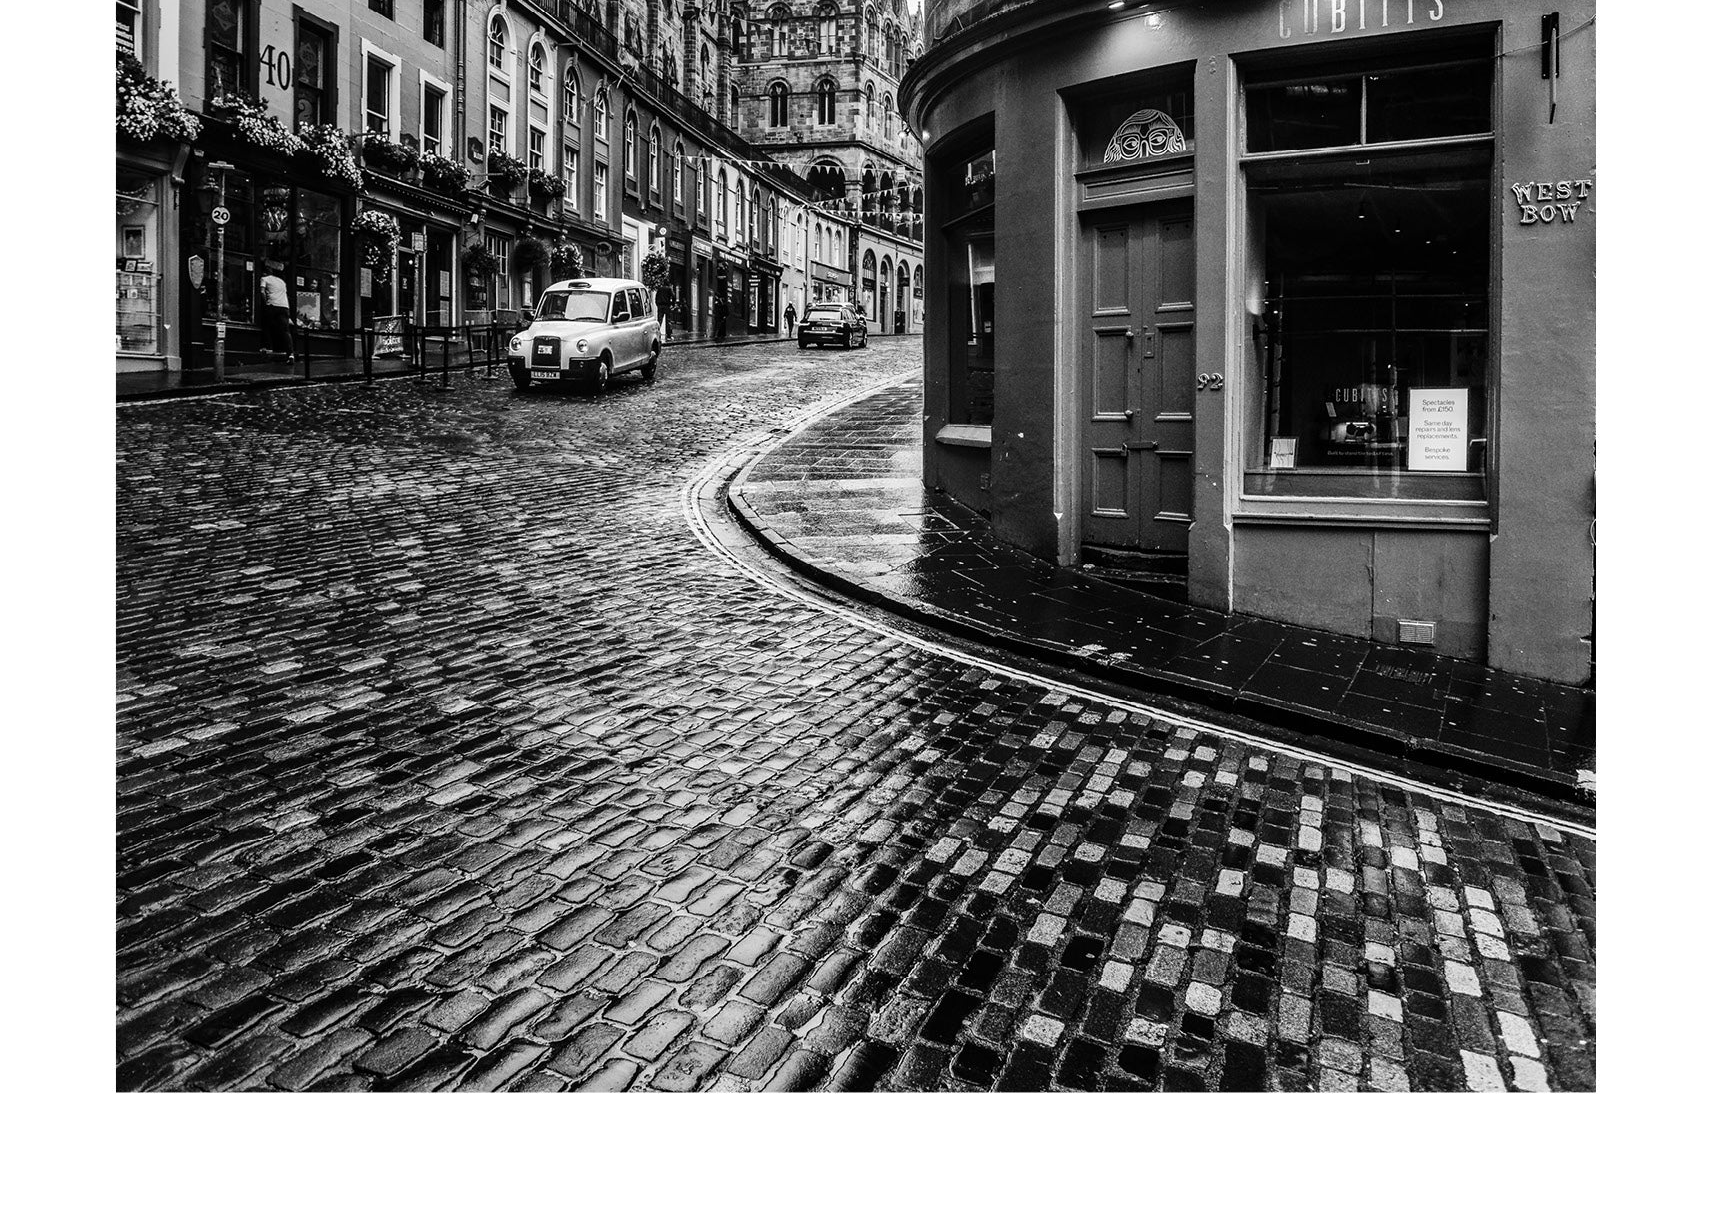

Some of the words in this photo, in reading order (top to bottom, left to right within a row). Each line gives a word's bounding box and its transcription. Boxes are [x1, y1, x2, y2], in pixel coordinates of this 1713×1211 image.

[259, 44, 291, 91] 40
[1511, 179, 1593, 205] WEST
[213, 210, 229, 221] 20
[1520, 201, 1581, 224] BOW
[1197, 372, 1223, 390] 92
